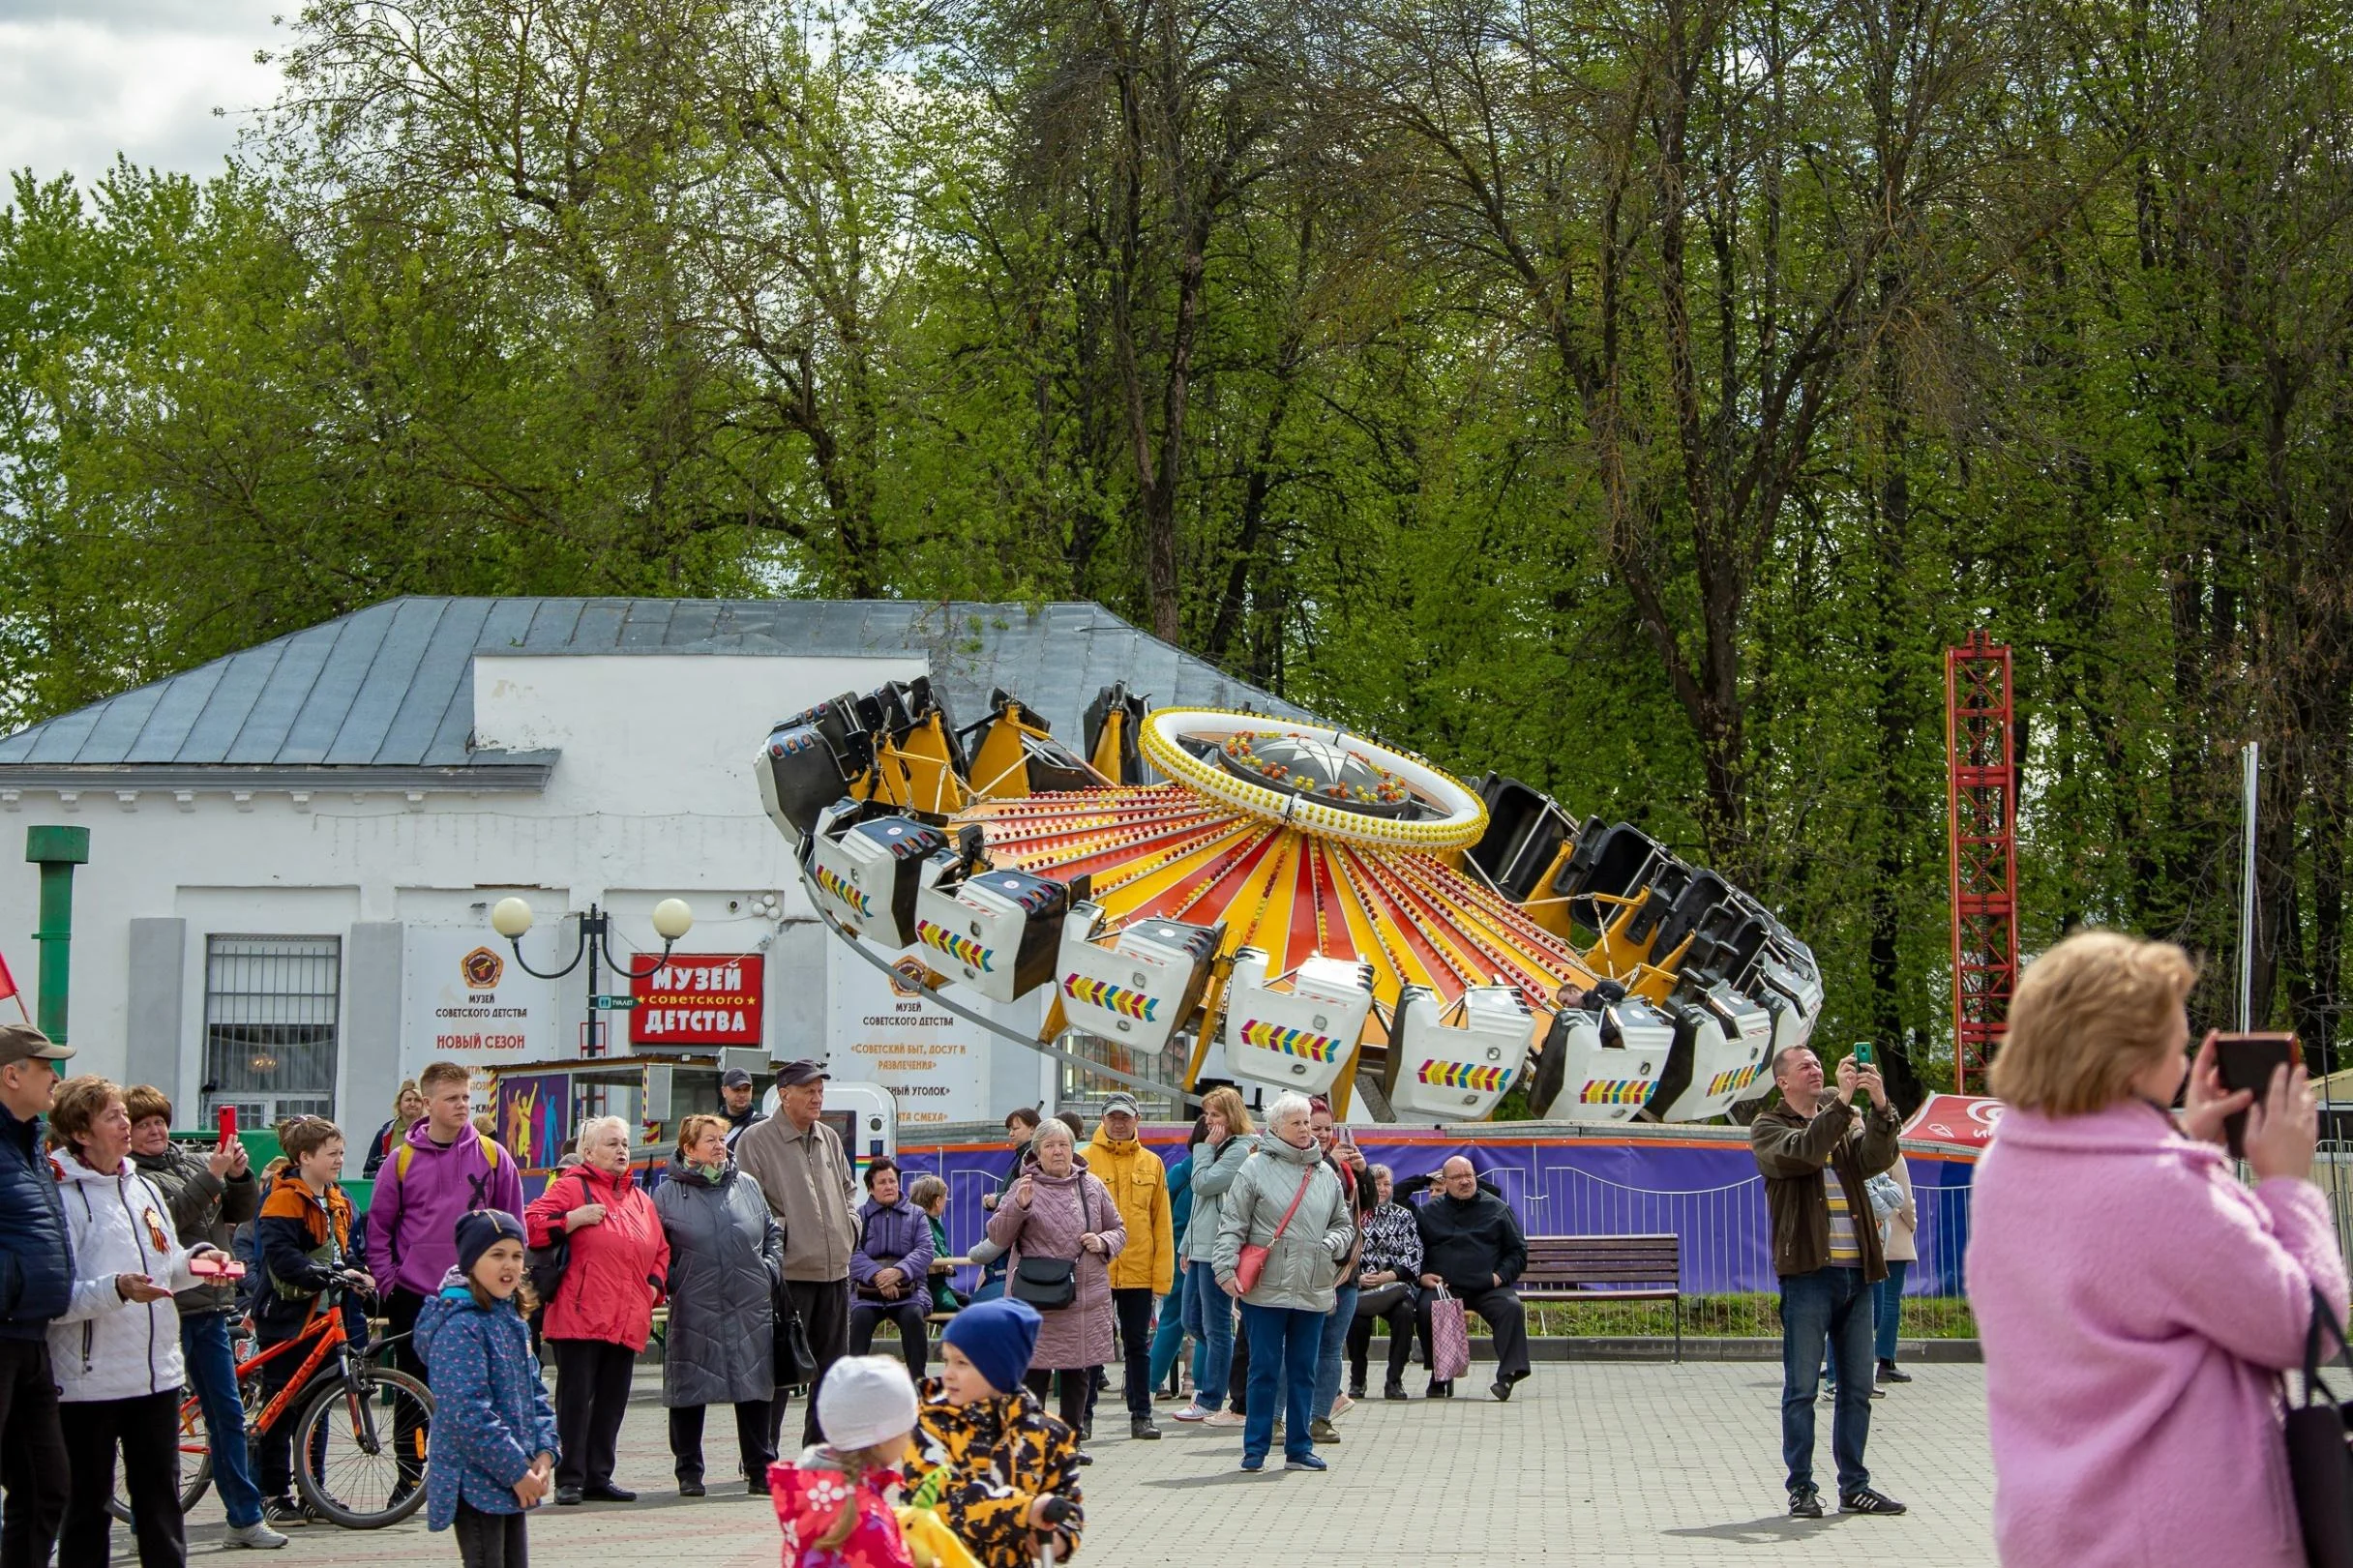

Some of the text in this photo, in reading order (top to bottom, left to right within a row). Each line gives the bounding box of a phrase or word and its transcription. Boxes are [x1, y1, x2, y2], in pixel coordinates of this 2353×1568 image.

[651, 961, 741, 991] МУЗЕЙ
[468, 993, 494, 1004] МУЗЕЙ
[896, 1001, 921, 1012] МУЗЕЙ
[435, 1008, 527, 1018] СОВЕТСКОГО ДЕТСТВА
[644, 1010, 746, 1034] ДЕТСТВА
[863, 1017, 954, 1026] СОВЕТСКОГО ДЕТСТВА
[436, 1033, 525, 1050] НОВЫЙ СЕЗОН
[929, 1045, 958, 1054] ДОСУГ
[960, 1045, 967, 1054] И
